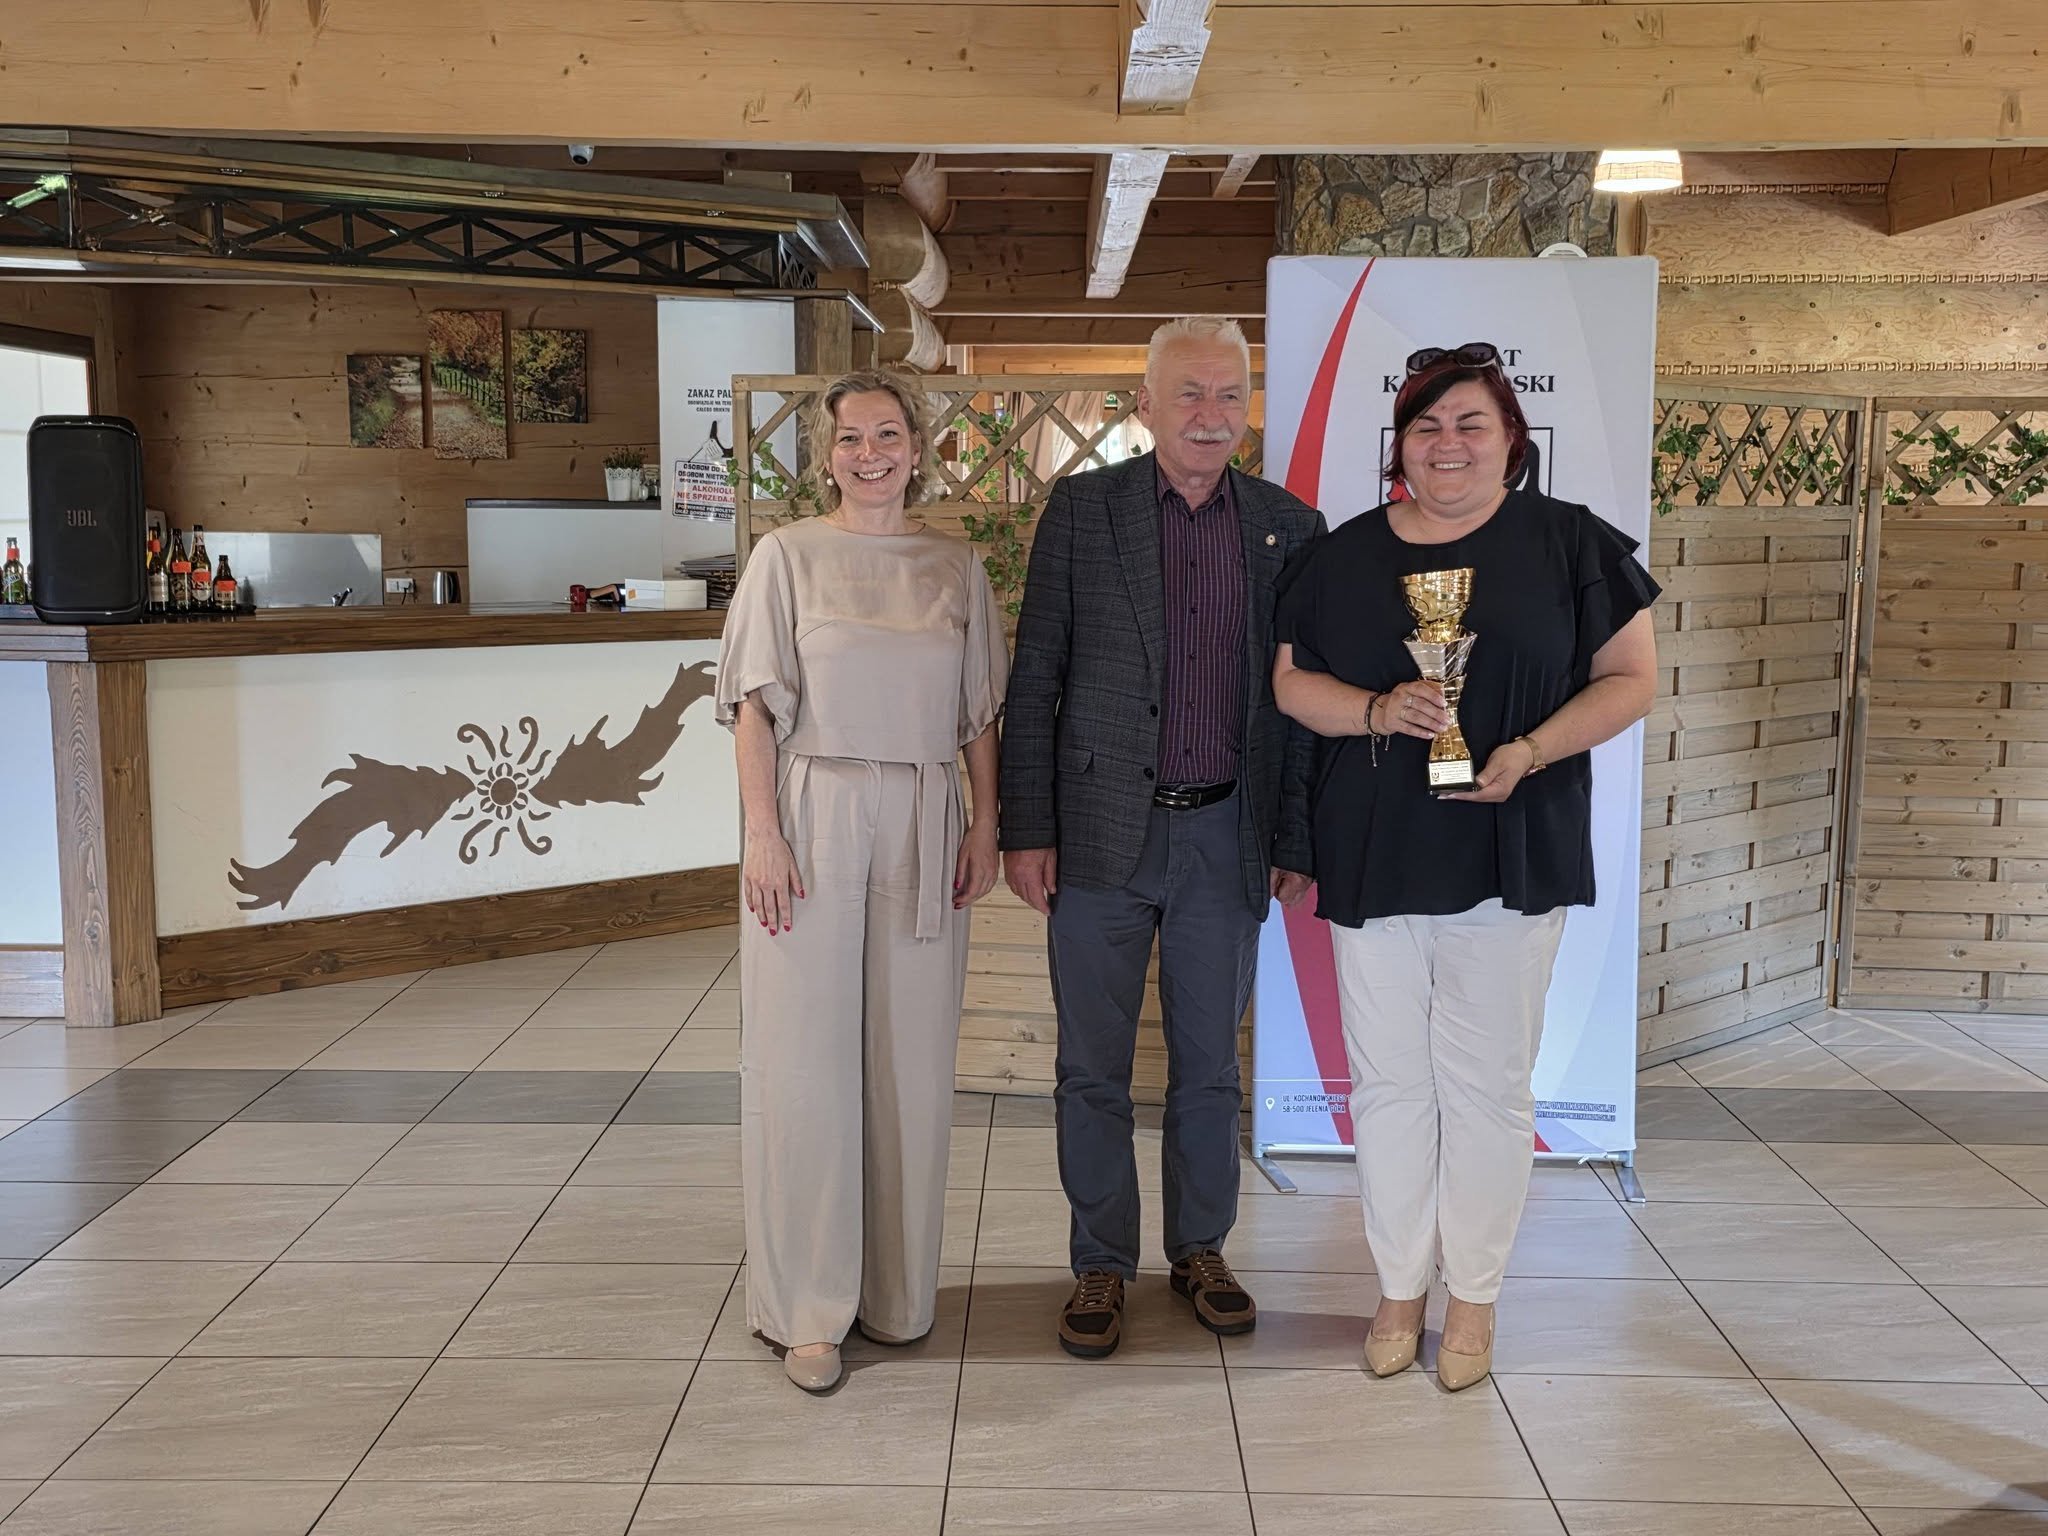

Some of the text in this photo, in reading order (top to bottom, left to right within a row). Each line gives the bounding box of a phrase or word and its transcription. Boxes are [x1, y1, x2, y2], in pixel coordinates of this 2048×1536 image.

[687, 389, 732, 398] ZAKAZ PAL
[683, 463, 710, 471] OSOBOM
[678, 470, 705, 478] OSOBOM
[67, 510, 97, 527] JBL
[1294, 1094, 1346, 1102] KOCHANOWSKIEGO
[1330, 1104, 1345, 1112] GÓRA
